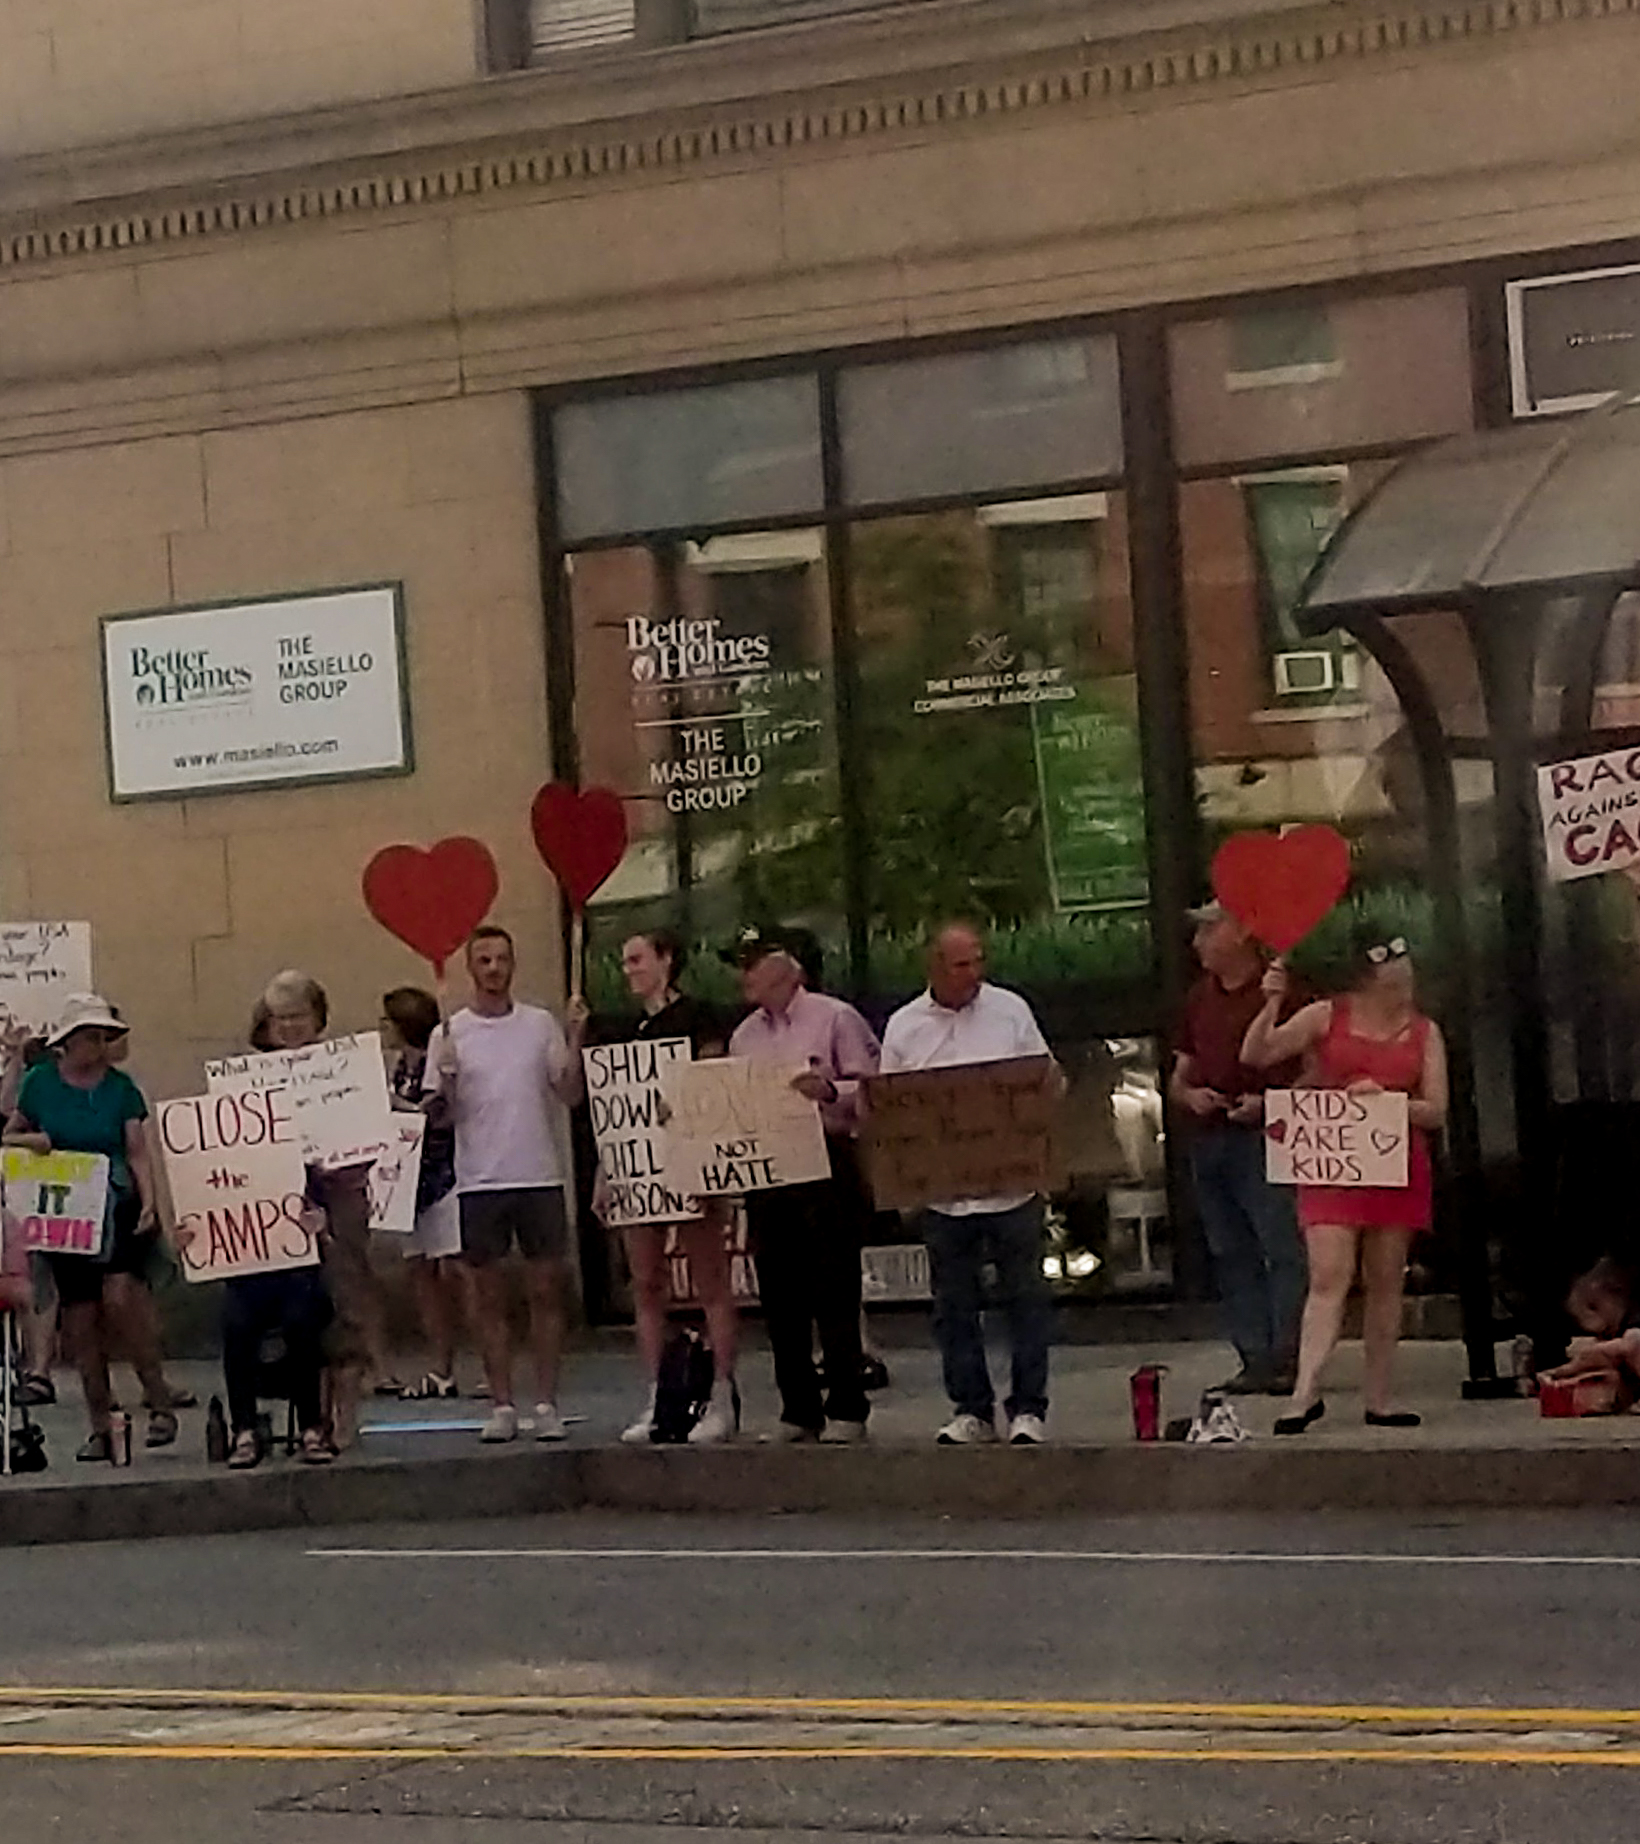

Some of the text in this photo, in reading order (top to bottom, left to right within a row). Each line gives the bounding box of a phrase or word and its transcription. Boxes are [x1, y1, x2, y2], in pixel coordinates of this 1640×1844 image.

[277, 634, 313, 657] THE
[625, 615, 722, 651] Better
[129, 646, 210, 678] Better
[278, 652, 373, 680] MASIELLO
[660, 635, 771, 680] Homes
[160, 664, 252, 704] Homes
[279, 679, 348, 704] GROUP
[173, 739, 339, 769] www.masiello.com
[680, 727, 725, 753] THE
[649, 753, 762, 785] MASIELLO
[666, 784, 747, 813] GROUP
[161, 1085, 296, 1154] CLOSE
[1291, 1090, 1368, 1122] KIDS
[714, 1139, 759, 1158] NOT
[1289, 1124, 1357, 1152] ARE
[206, 1167, 250, 1190] the
[702, 1157, 784, 1191] HATE
[1291, 1154, 1362, 1182] KIDS
[37, 1184, 72, 1215] IT
[22, 1215, 96, 1250] OWN
[177, 1192, 313, 1270] CAMPS
